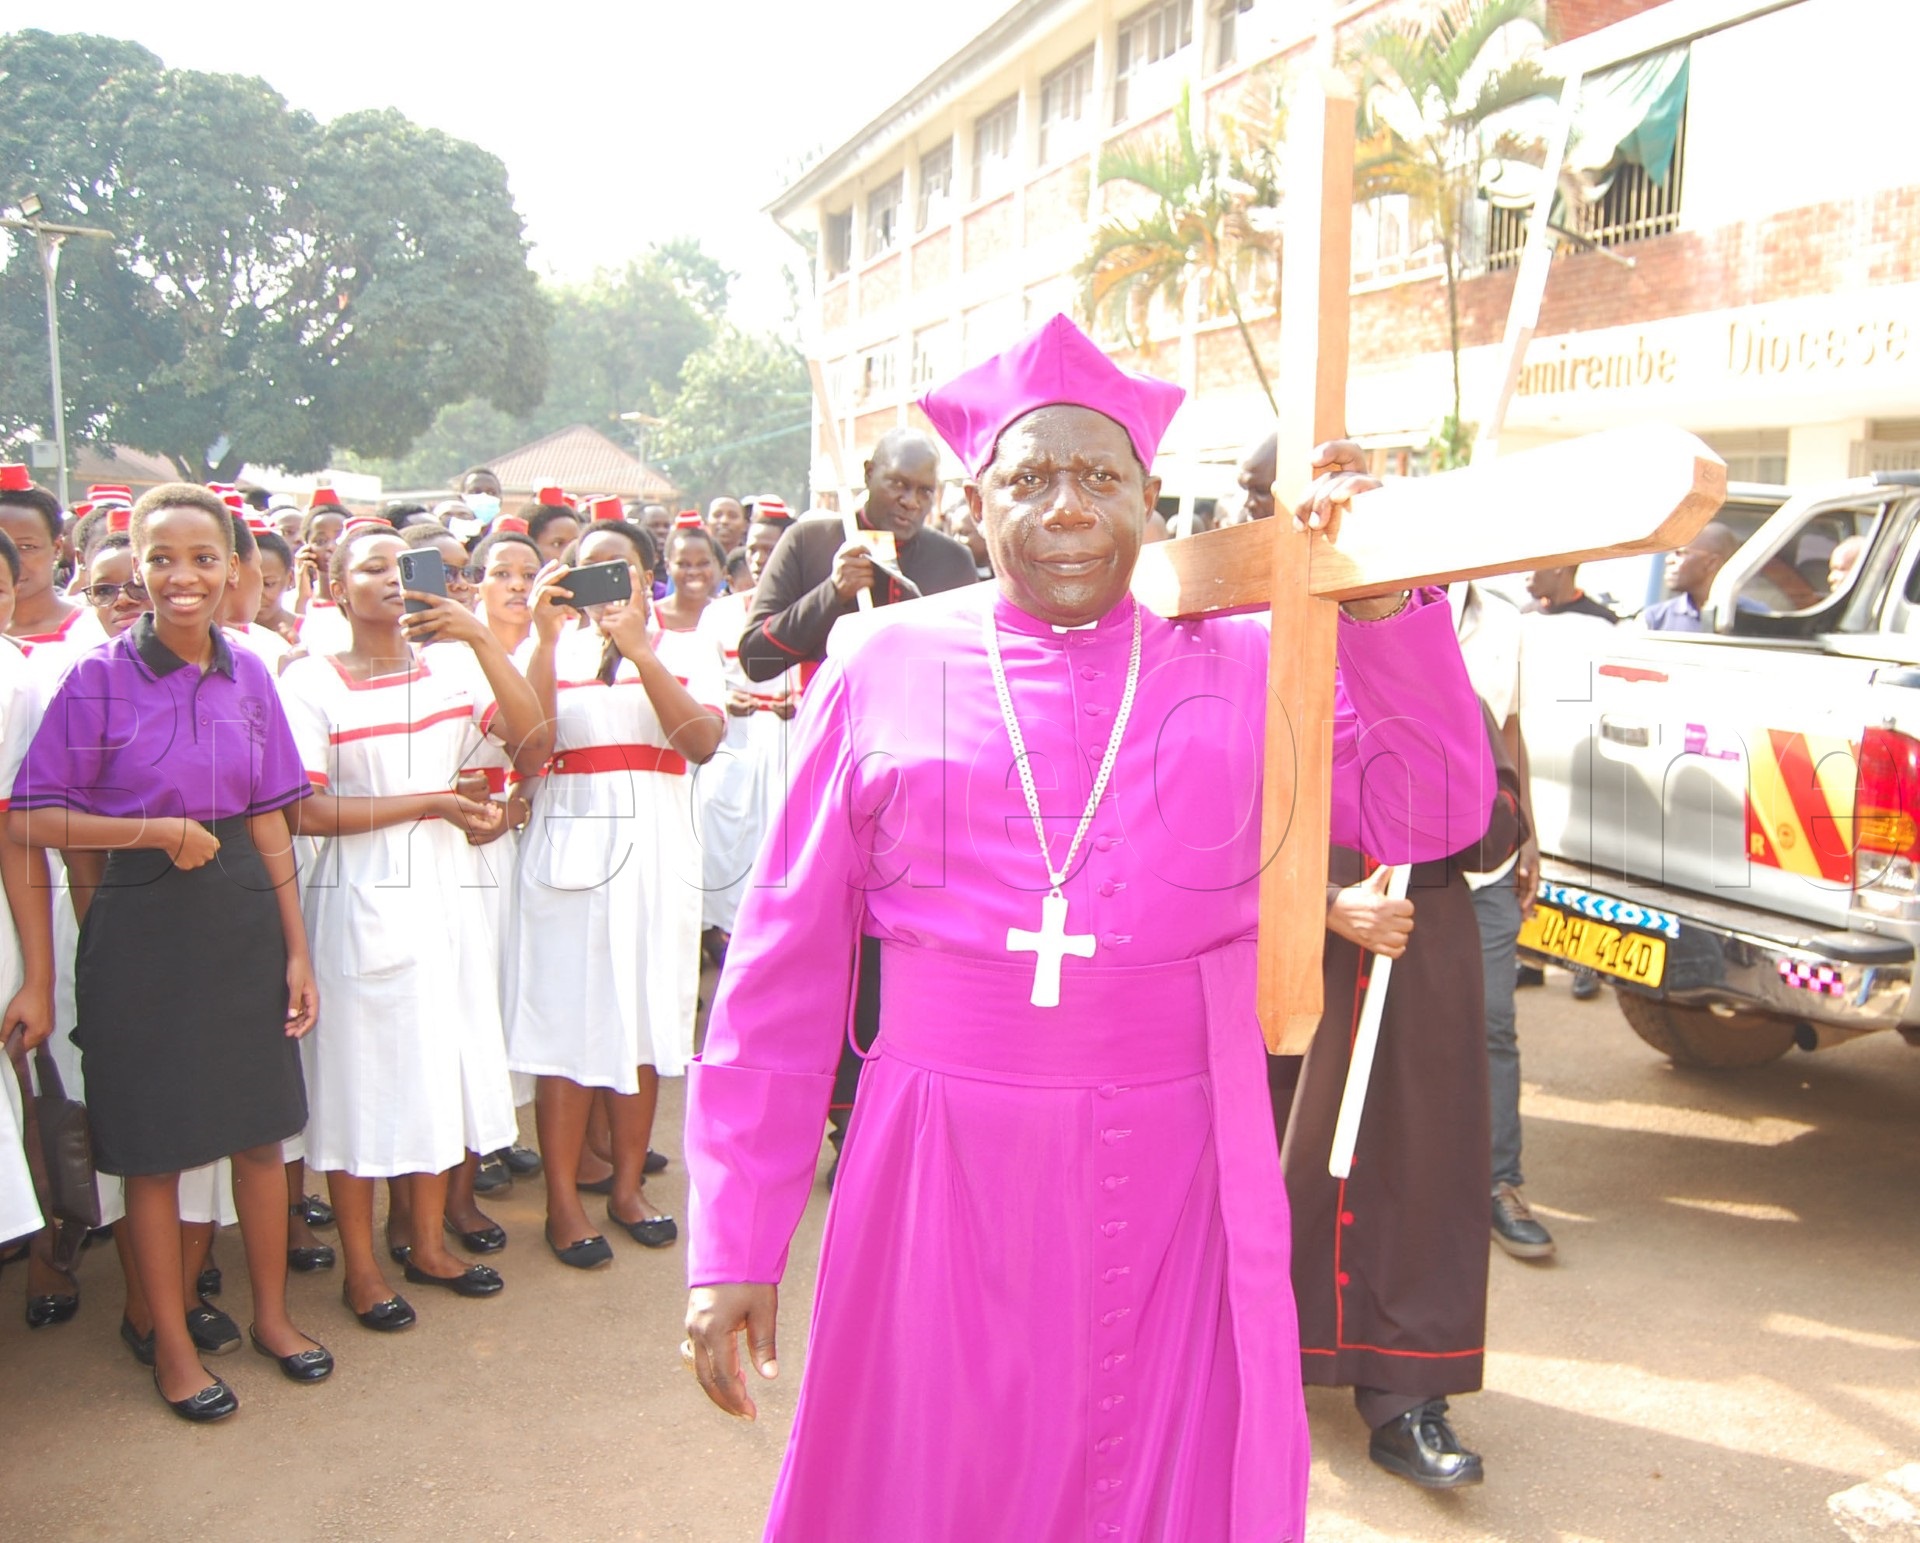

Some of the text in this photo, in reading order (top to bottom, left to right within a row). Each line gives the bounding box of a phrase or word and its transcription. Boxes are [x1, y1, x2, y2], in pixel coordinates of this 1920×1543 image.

[1517, 319, 1909, 396] amirembe Diocese
[1594, 929, 1652, 977] 414D
